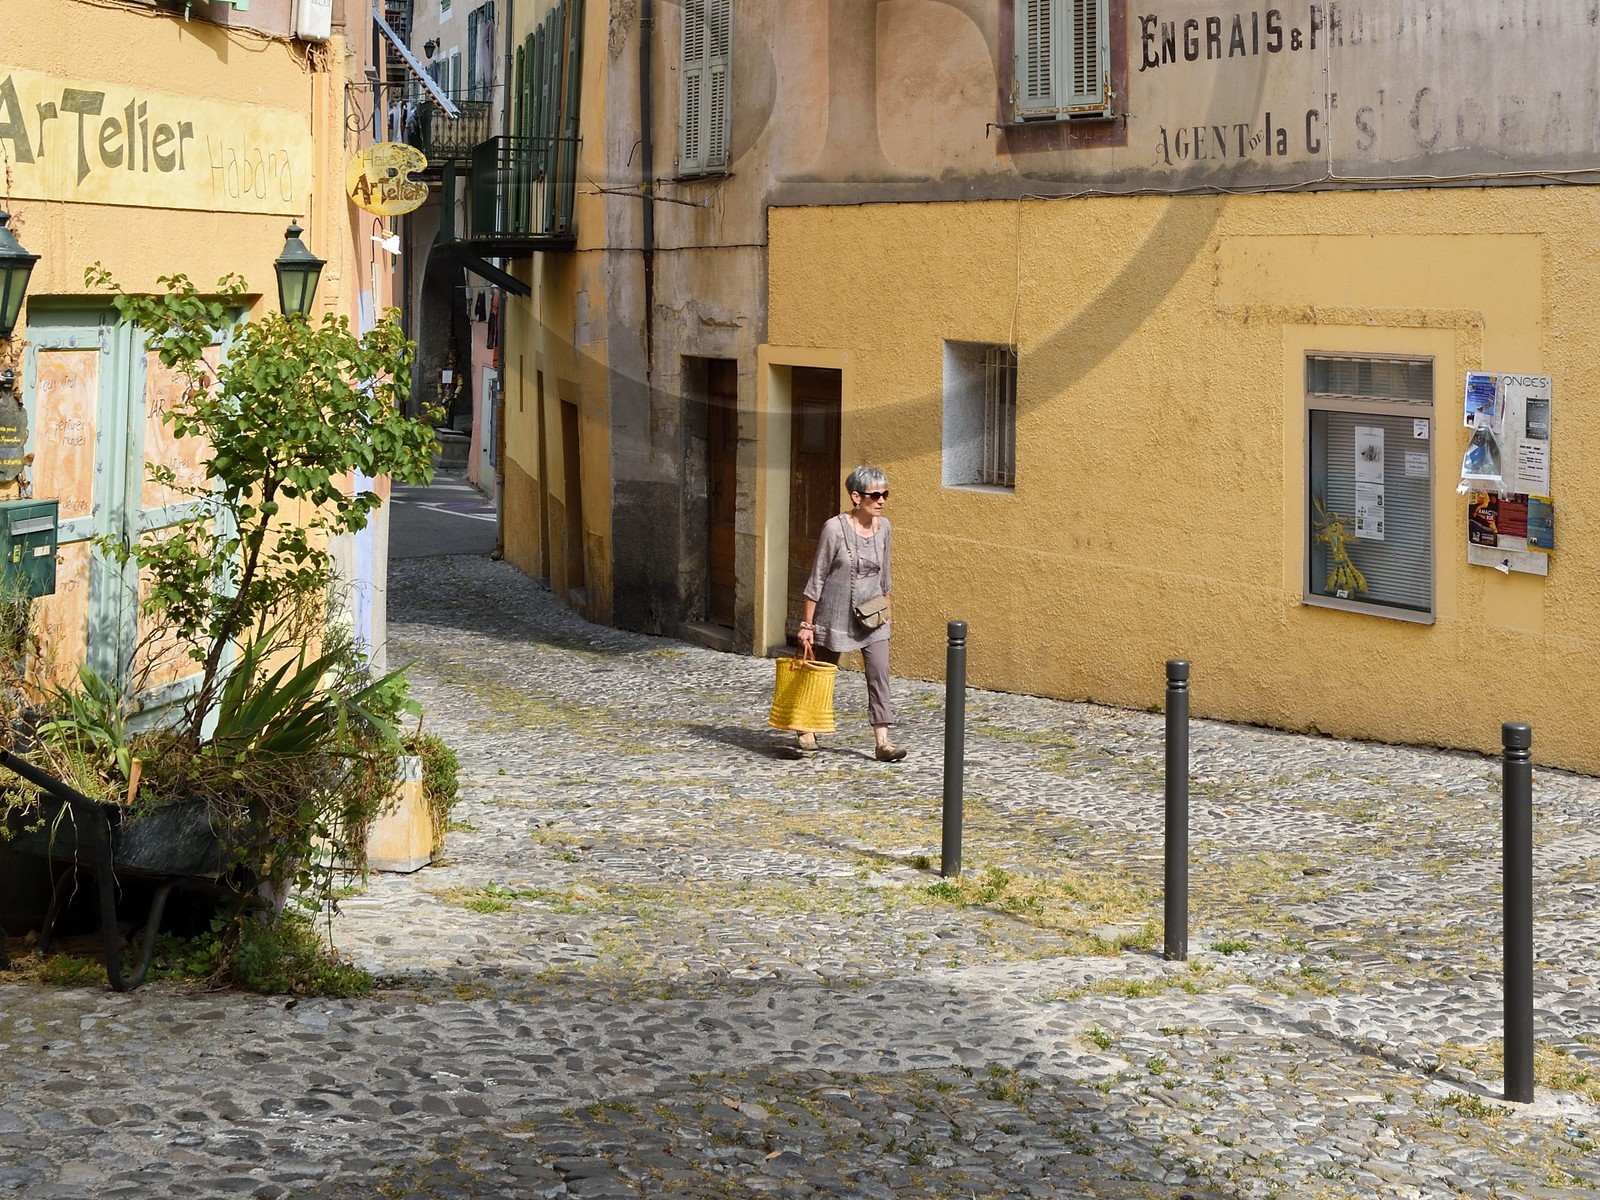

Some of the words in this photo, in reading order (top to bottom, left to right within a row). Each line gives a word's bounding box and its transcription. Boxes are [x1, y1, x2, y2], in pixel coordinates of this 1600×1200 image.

[1138, 9, 1283, 72] ENGRAIS
[1290, 28, 1303, 51] &
[206, 132, 293, 203] Habana
[1152, 124, 1249, 166] AGENT
[1265, 112, 1288, 156] la
[1502, 376, 1547, 388] ONCES
